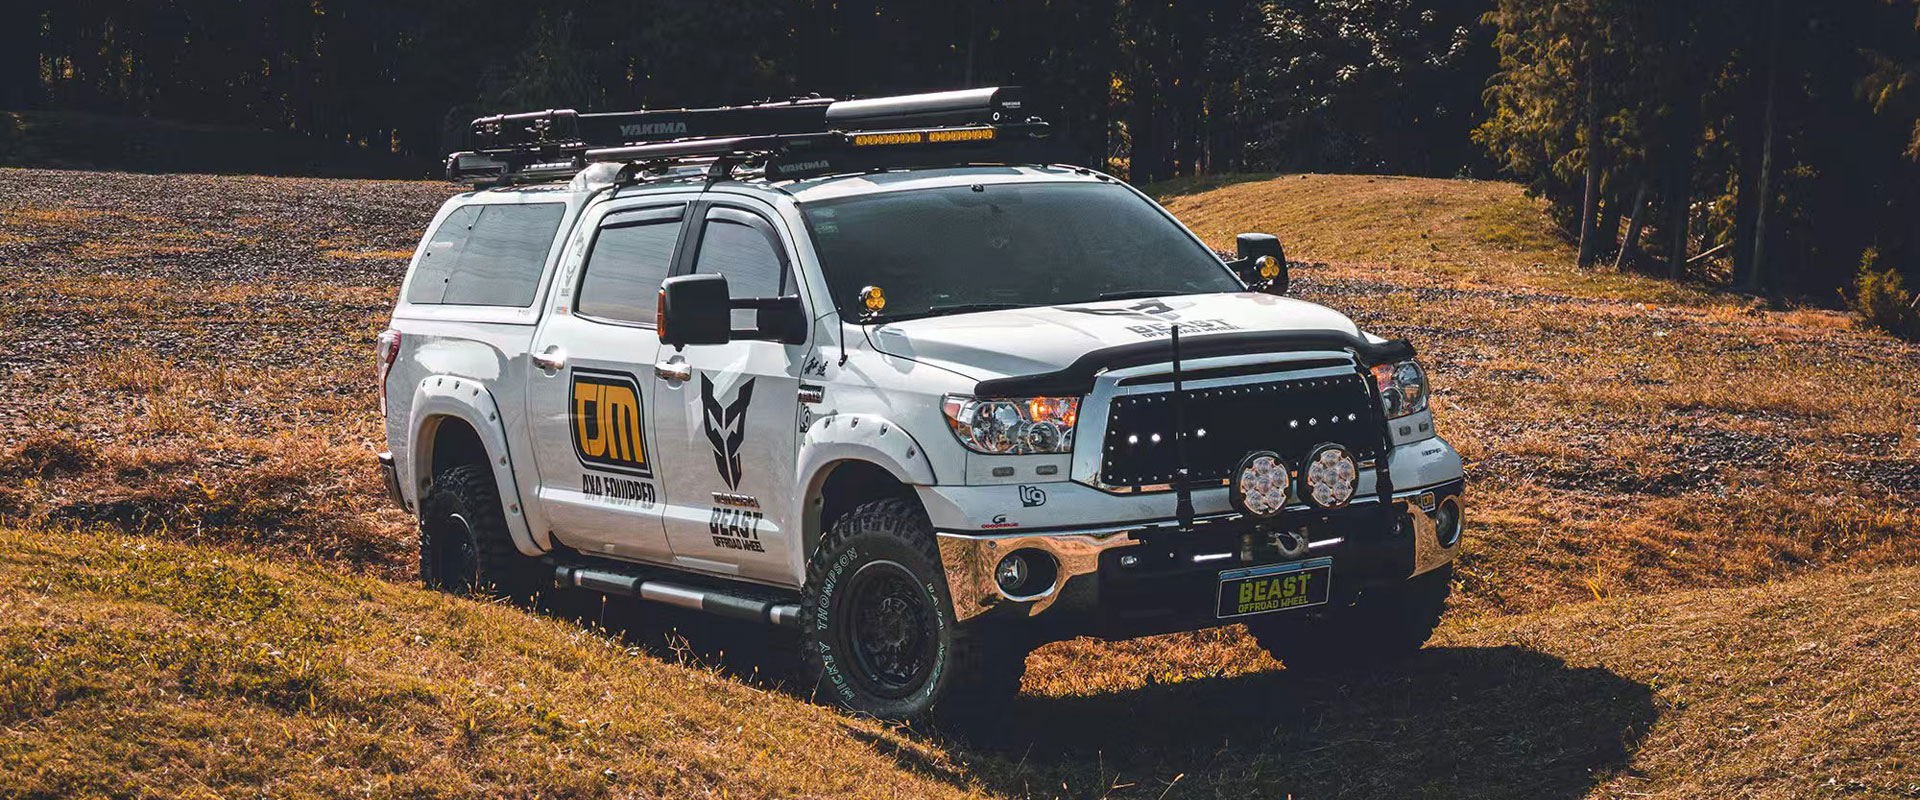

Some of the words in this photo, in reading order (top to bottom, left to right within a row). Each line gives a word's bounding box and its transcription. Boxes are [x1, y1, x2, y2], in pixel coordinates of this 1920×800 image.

[618, 122, 688, 137] YAKIMA
[778, 160, 830, 172] YAKIMA
[1125, 318, 1229, 334] BEAST
[1142, 325, 1202, 338] OFFOAD
[603, 477, 656, 511] EQUIPPED
[709, 507, 763, 540] BEAST
[712, 536, 743, 550] OFFROAD
[741, 539, 766, 553] WHEEL
[816, 547, 858, 631] THOMPSON
[1238, 574, 1311, 604] BEAST
[1237, 600, 1279, 613] OFFROAD
[1280, 595, 1309, 608] WHEEL
[818, 641, 856, 701] MICKEY
